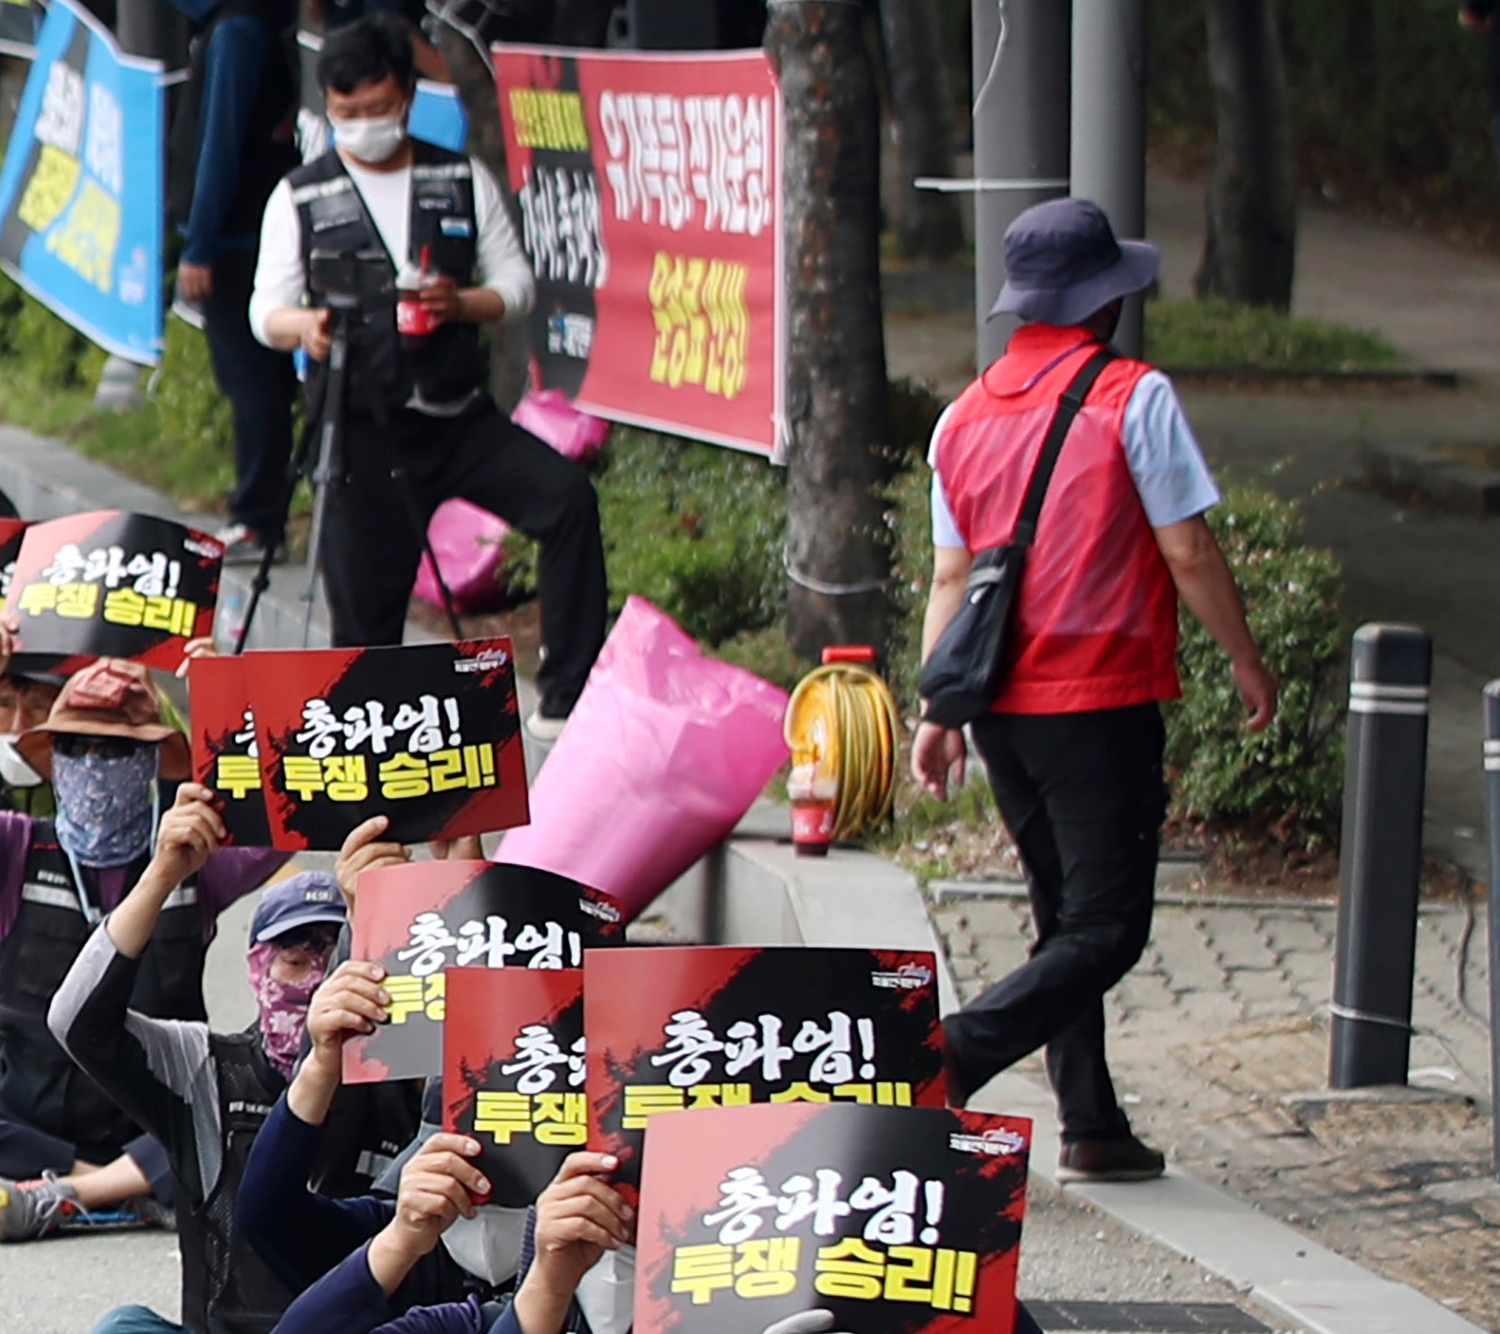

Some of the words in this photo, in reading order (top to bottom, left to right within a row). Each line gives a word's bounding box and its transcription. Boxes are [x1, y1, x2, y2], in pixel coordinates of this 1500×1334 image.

[38, 538, 179, 599] 총파업!
[17, 583, 98, 622] 투쟁
[104, 587, 196, 636] 승리!
[297, 696, 460, 757] 총파업!
[285, 755, 368, 801] 투쟁
[379, 745, 495, 798] 승리!
[396, 909, 580, 977] 총파업!
[652, 1011, 874, 1083] 총파업!
[701, 1164, 943, 1247] 총파업!
[670, 1237, 798, 1307] 투쟁
[819, 1243, 977, 1312] 승리!
